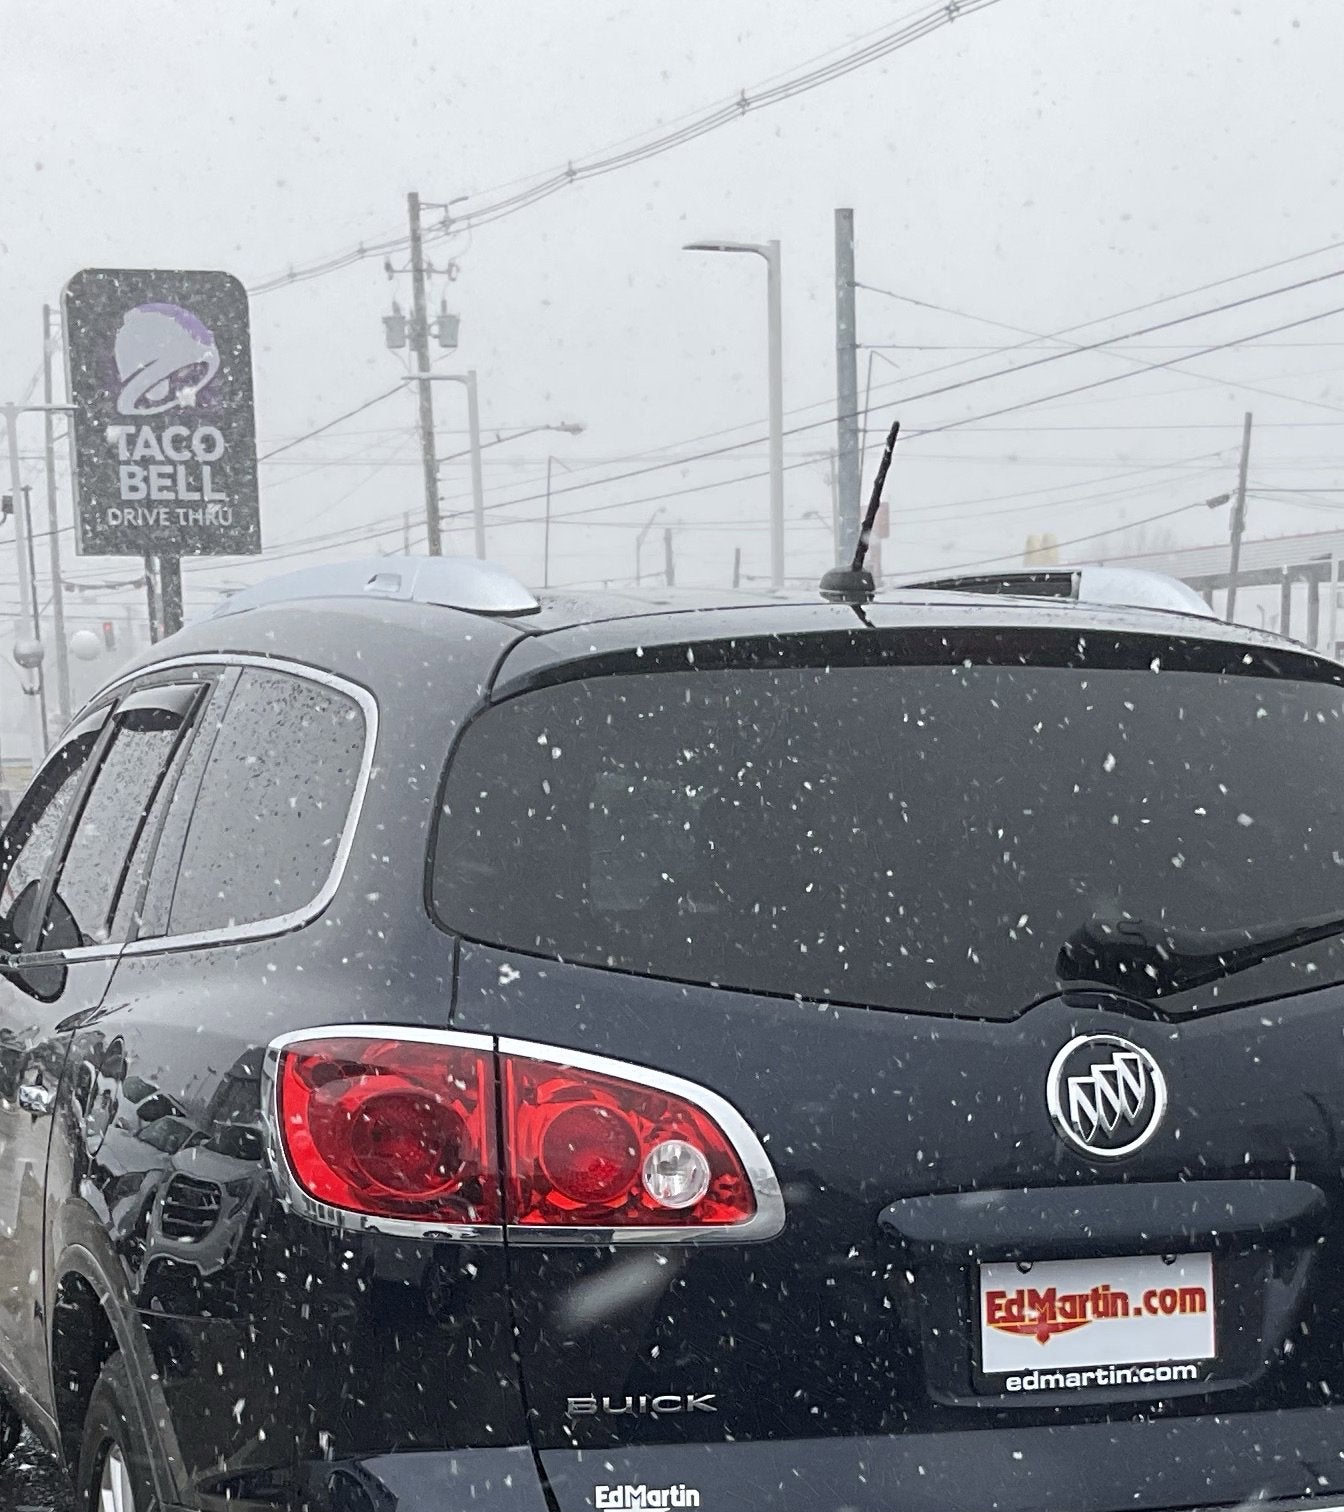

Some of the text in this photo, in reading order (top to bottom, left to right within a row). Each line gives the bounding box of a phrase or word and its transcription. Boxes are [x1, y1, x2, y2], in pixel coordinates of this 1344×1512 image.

[108, 424, 225, 462] TACO
[118, 464, 227, 501] BELL
[107, 505, 233, 526] DRIVE THRU
[985, 1284, 1208, 1329] EdMartin.com
[1005, 1363, 1198, 1393] edmartin.com
[567, 1393, 718, 1415] BUICK
[595, 1483, 700, 1512] EdMartin
